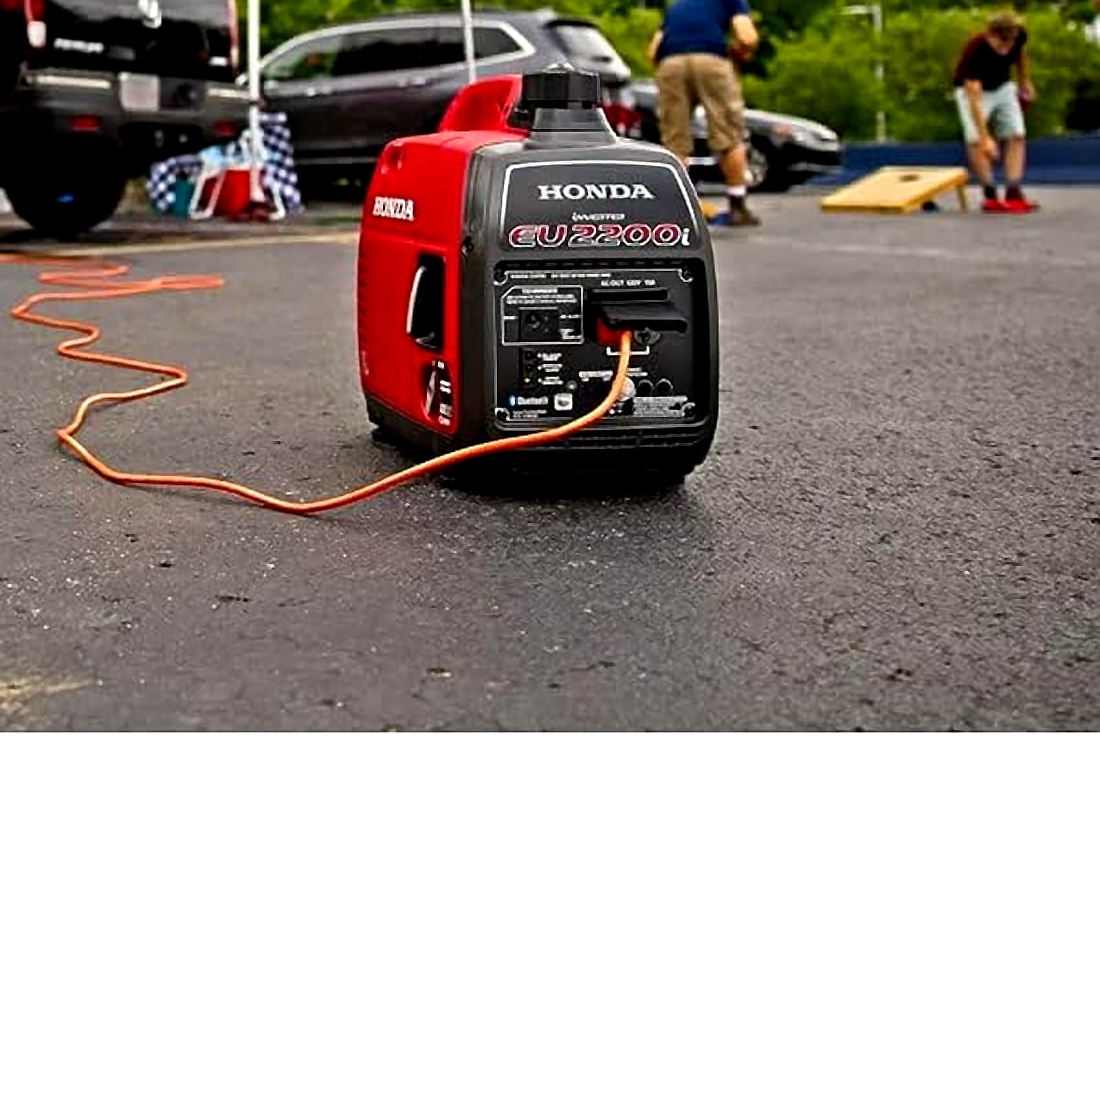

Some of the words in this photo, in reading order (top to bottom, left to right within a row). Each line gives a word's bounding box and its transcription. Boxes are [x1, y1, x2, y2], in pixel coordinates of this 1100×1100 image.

[537, 184, 655, 200] HONDA
[372, 196, 414, 221] HONDA
[508, 223, 690, 248] EU2200i
